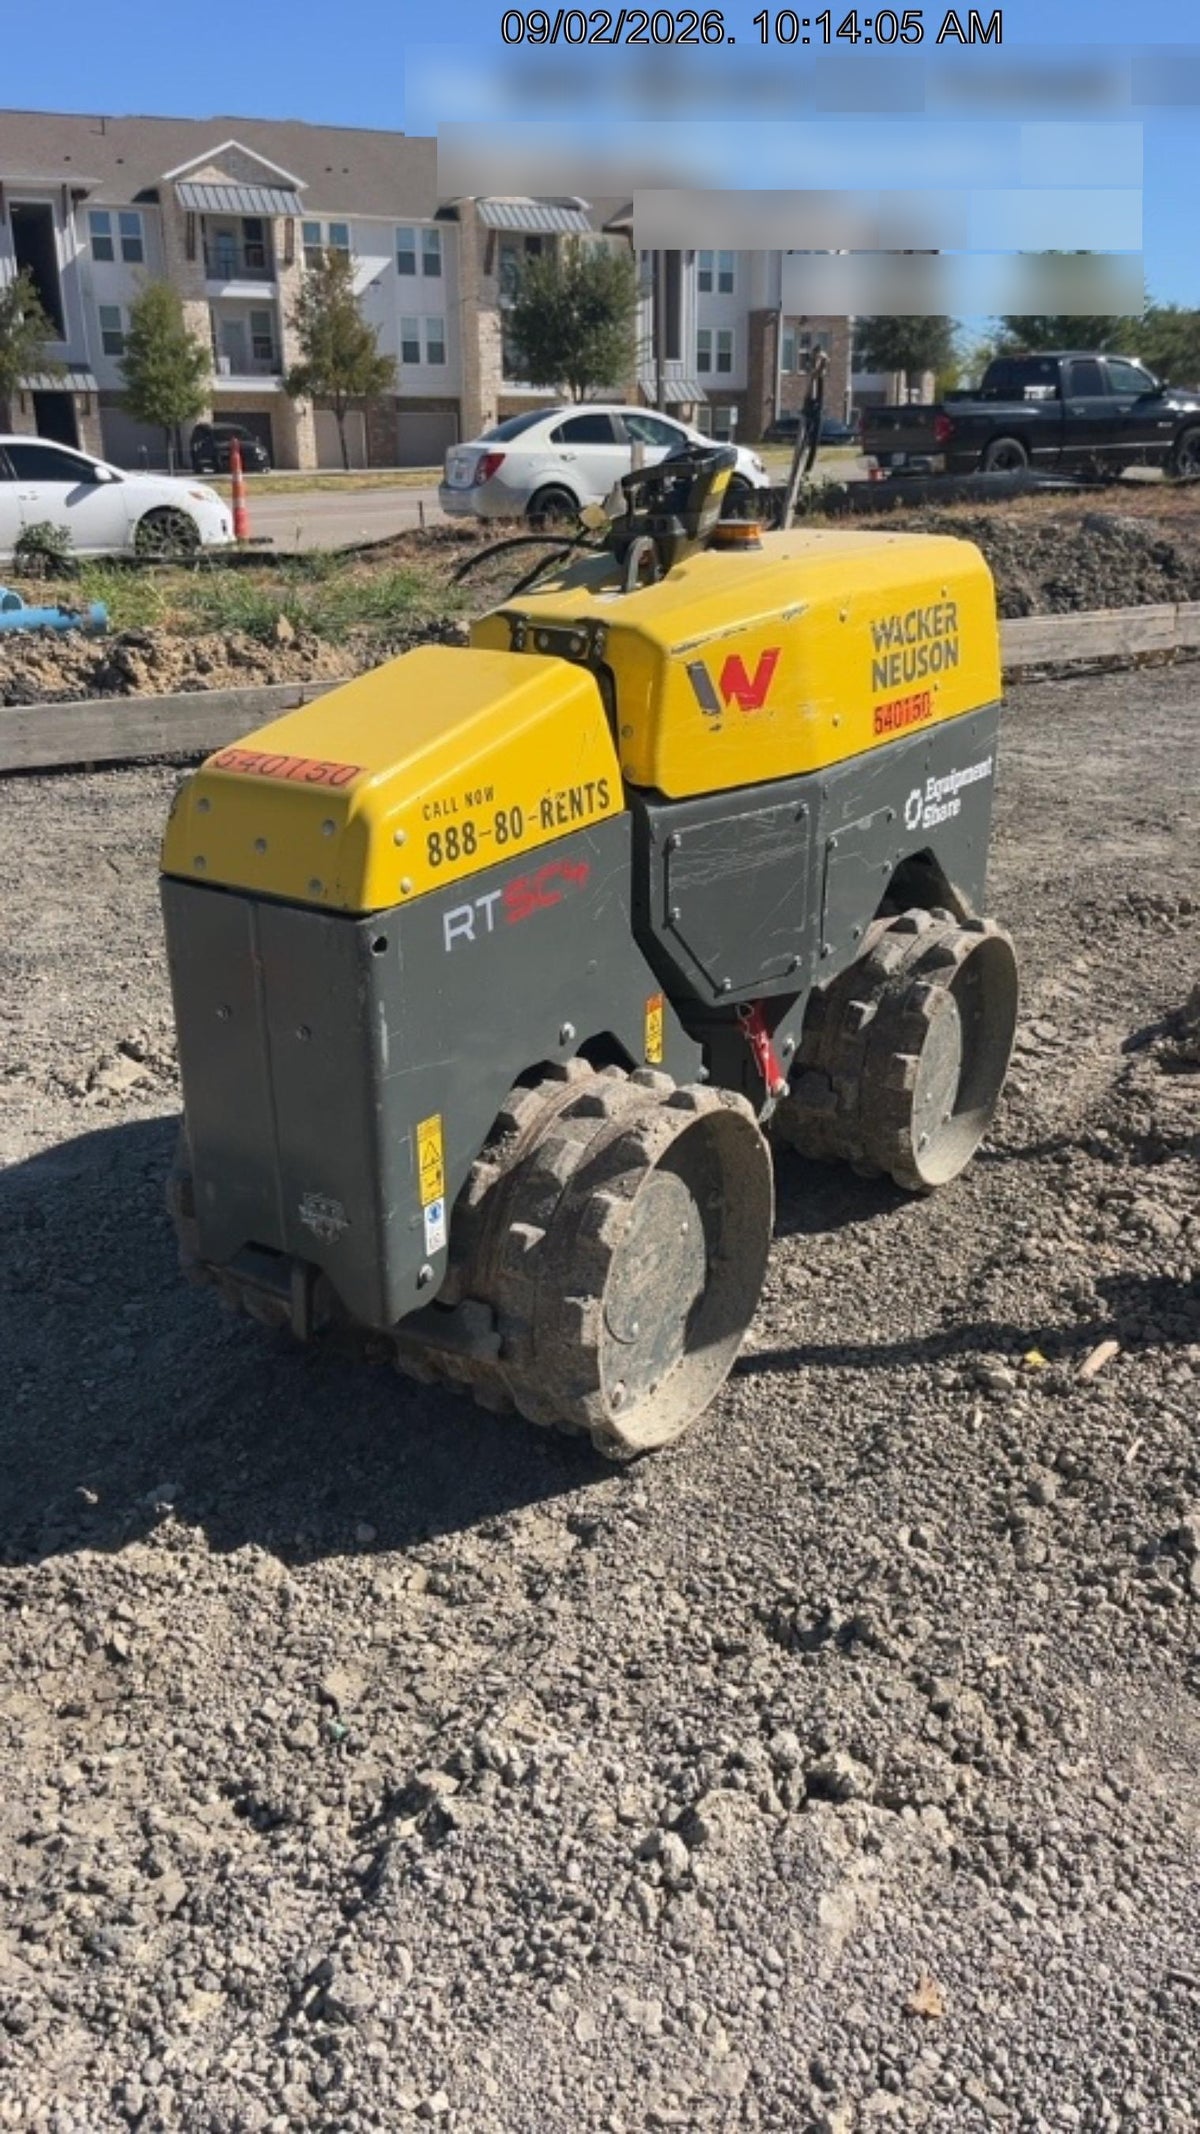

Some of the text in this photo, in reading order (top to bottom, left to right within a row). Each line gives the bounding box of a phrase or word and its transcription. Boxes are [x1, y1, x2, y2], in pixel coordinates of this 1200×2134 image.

[871, 601, 958, 653] WACKER
[871, 637, 960, 693] NEUSON
[214, 748, 363, 786] 540150
[924, 755, 992, 802] Equipment
[422, 784, 496, 821] CALL NOW
[427, 778, 611, 867] 888-80-RENTS
[921, 797, 962, 829] Share
